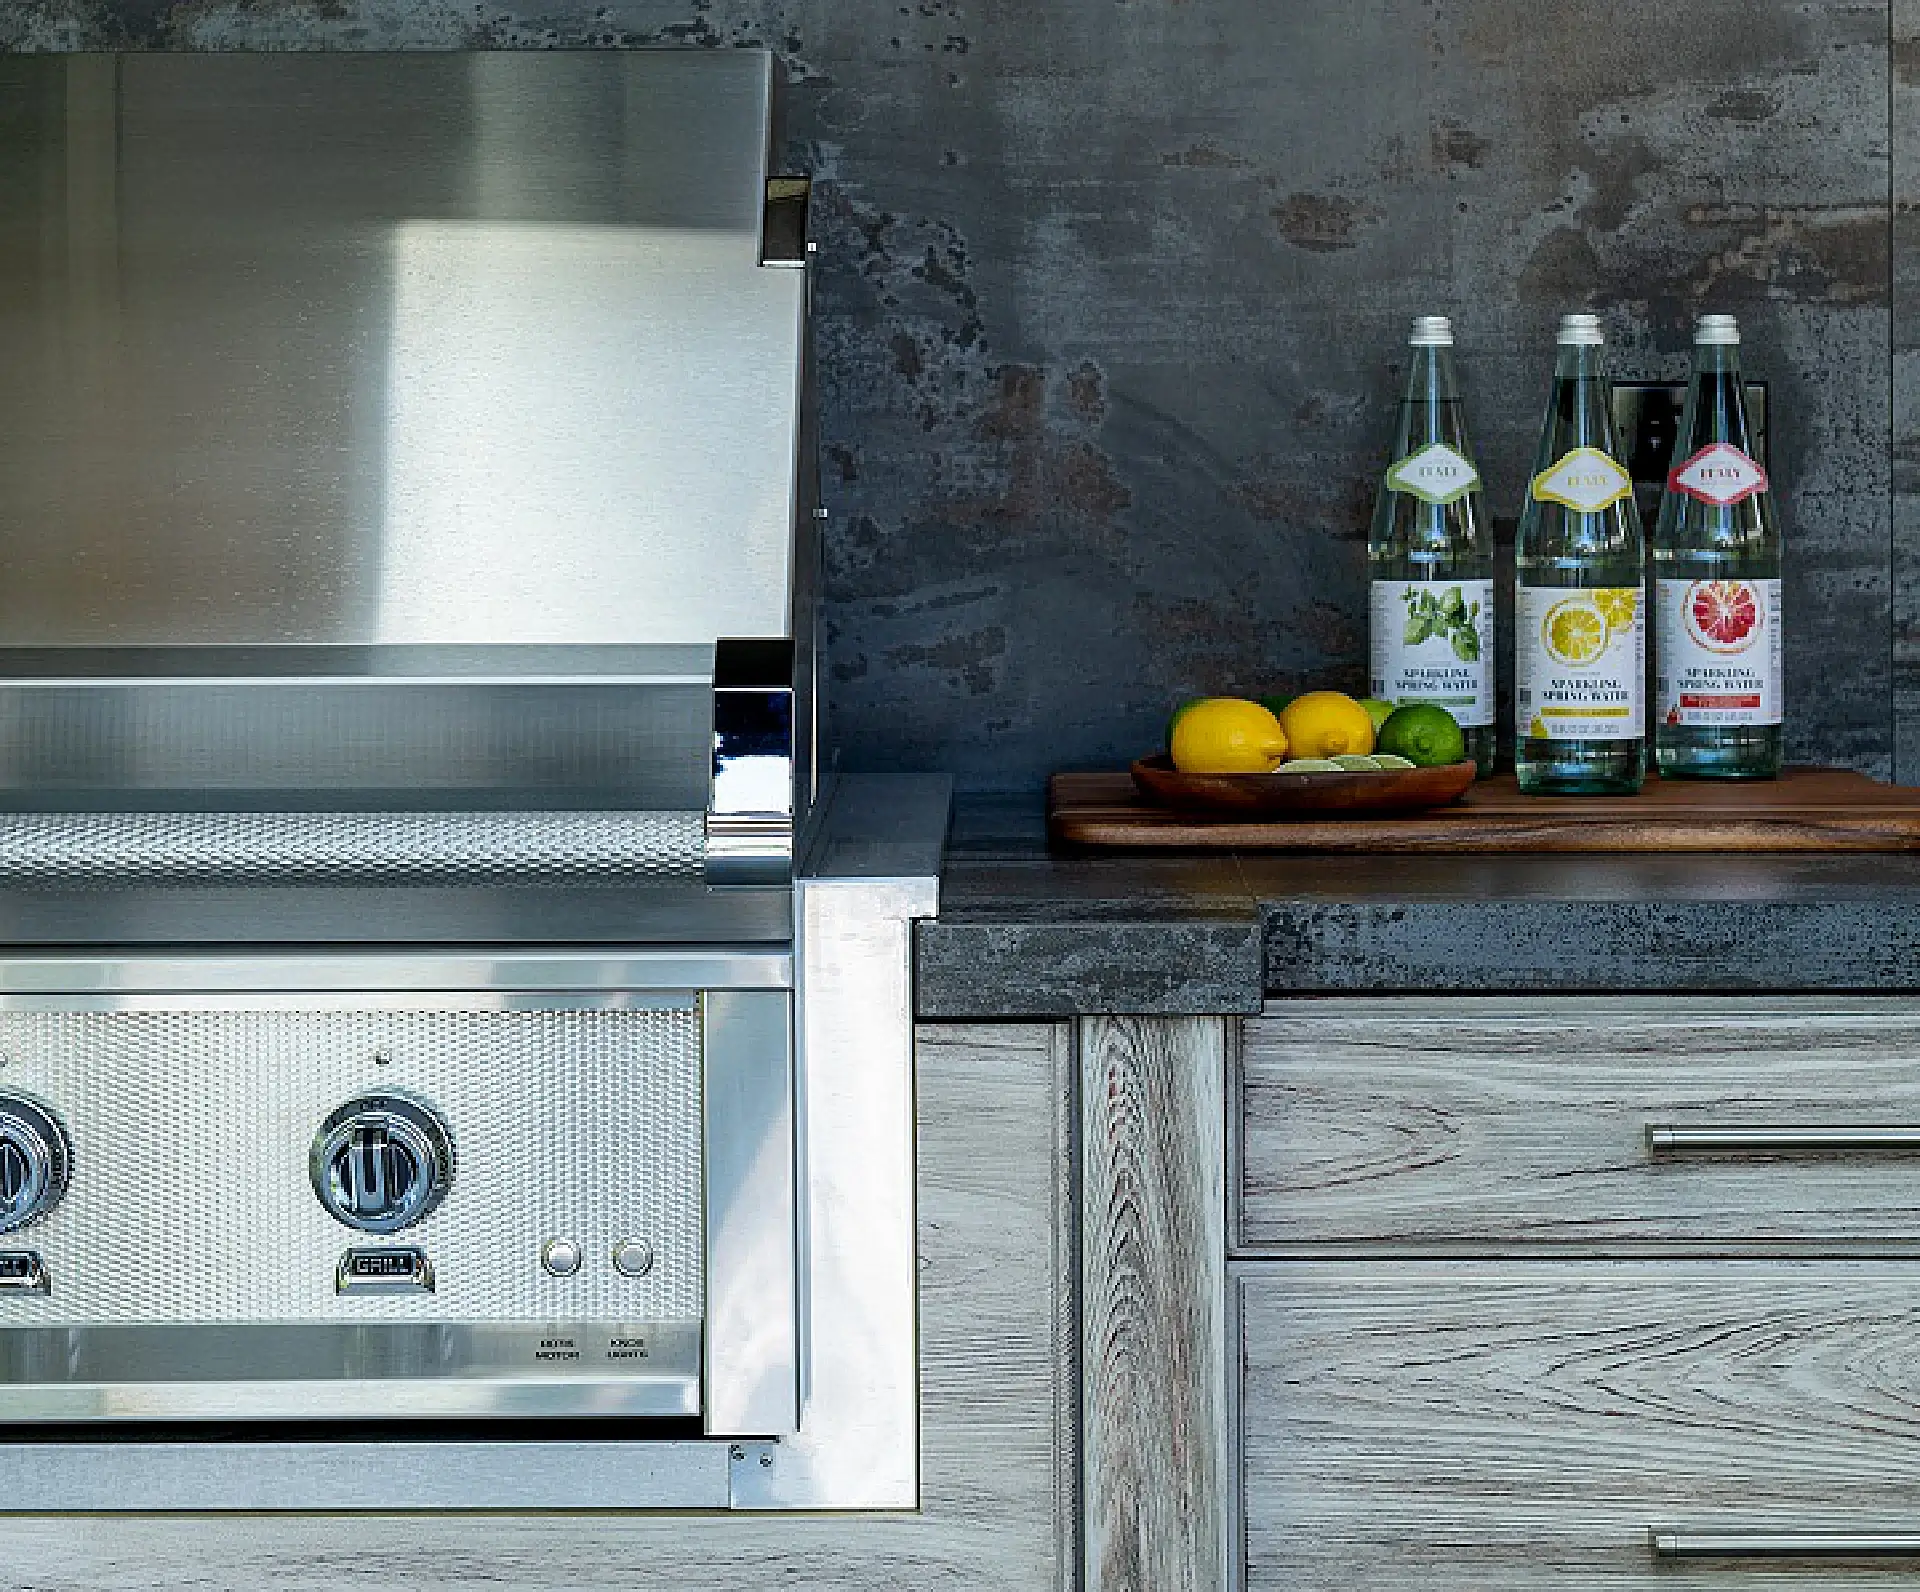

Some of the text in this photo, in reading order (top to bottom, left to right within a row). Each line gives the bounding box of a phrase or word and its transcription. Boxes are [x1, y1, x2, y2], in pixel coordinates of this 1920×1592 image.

[1402, 668, 1470, 677] SPARKLING
[1684, 668, 1756, 678] SPARKLING
[1395, 680, 1478, 690] SPRING WATER
[1551, 679, 1621, 689] SPARKLING
[1677, 680, 1763, 690] SPRING WATER
[1541, 691, 1629, 701] SPRING WATER
[611, 1339, 644, 1348] KNOB
